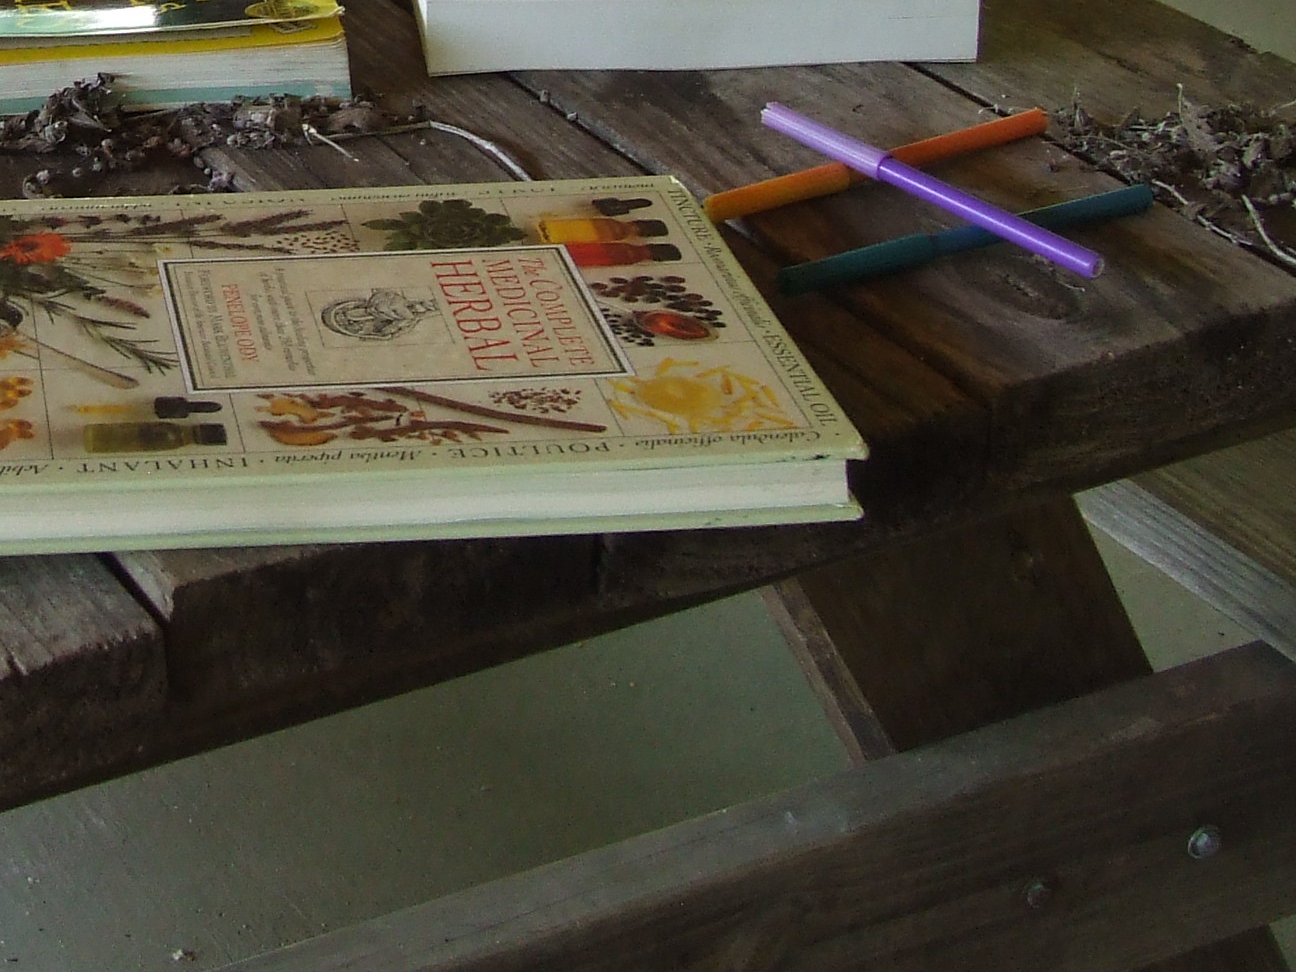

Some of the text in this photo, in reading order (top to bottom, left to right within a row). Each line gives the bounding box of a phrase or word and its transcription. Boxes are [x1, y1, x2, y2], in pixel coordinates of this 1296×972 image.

[221, 284, 259, 362] PENELOPE ODY
[430, 260, 518, 370] HERBAL
[482, 260, 559, 367] MEDICINAL
[518, 258, 594, 366] The COMPLETE
[668, 189, 711, 240] TINCTURE
[763, 335, 819, 401] ESSENTIAL
[810, 403, 837, 426] OIL
[77, 458, 247, 473] INHALANT
[448, 442, 609, 458] POULTICE
[730, 431, 820, 444] Calendula
